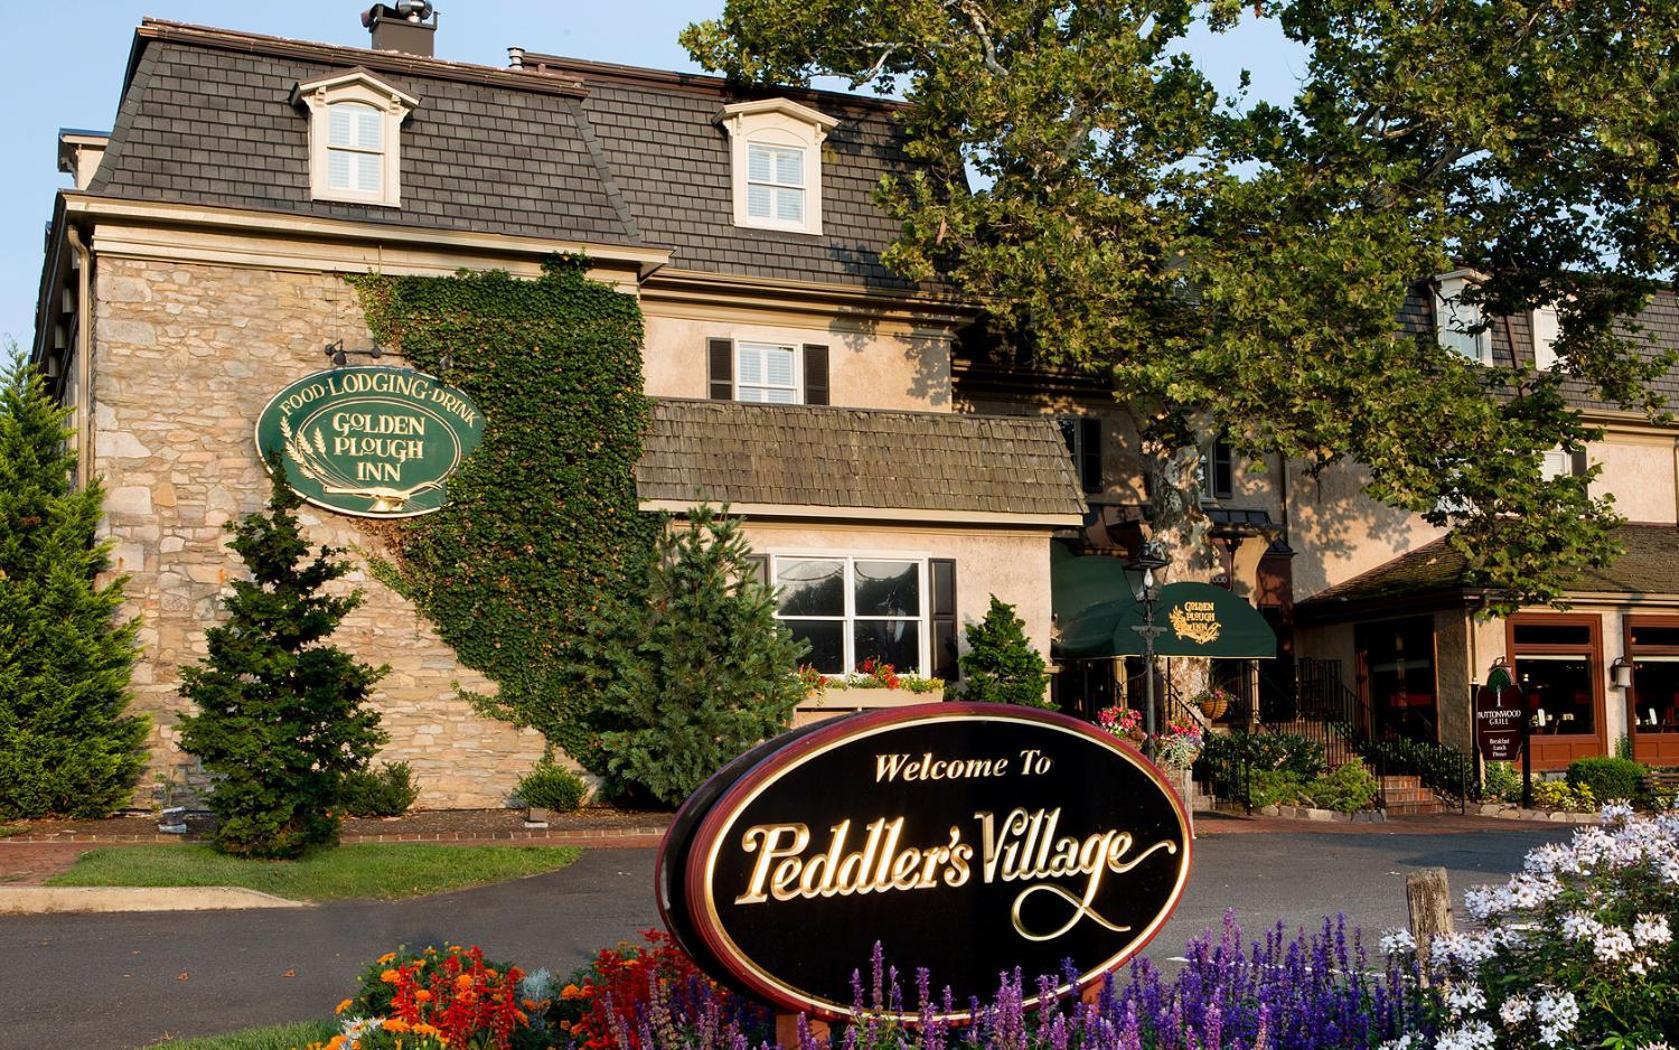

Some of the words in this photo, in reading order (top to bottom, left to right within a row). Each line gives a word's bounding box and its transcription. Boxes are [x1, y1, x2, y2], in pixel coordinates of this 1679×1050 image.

[279, 384, 326, 416] FOOD
[327, 373, 429, 400] LODGING
[432, 388, 480, 428] DRINK
[332, 413, 426, 436] GOLDEN
[333, 437, 424, 463] PLOUGH
[356, 462, 401, 481] INN
[1184, 601, 1215, 612] GOLDEN
[1185, 612, 1215, 623] PLOUGH
[1489, 718, 1509, 726] GRILL
[875, 752, 1007, 784] Welcome
[1020, 749, 1053, 776] To
[734, 816, 973, 905] Peddler's
[974, 807, 1177, 941] Village
